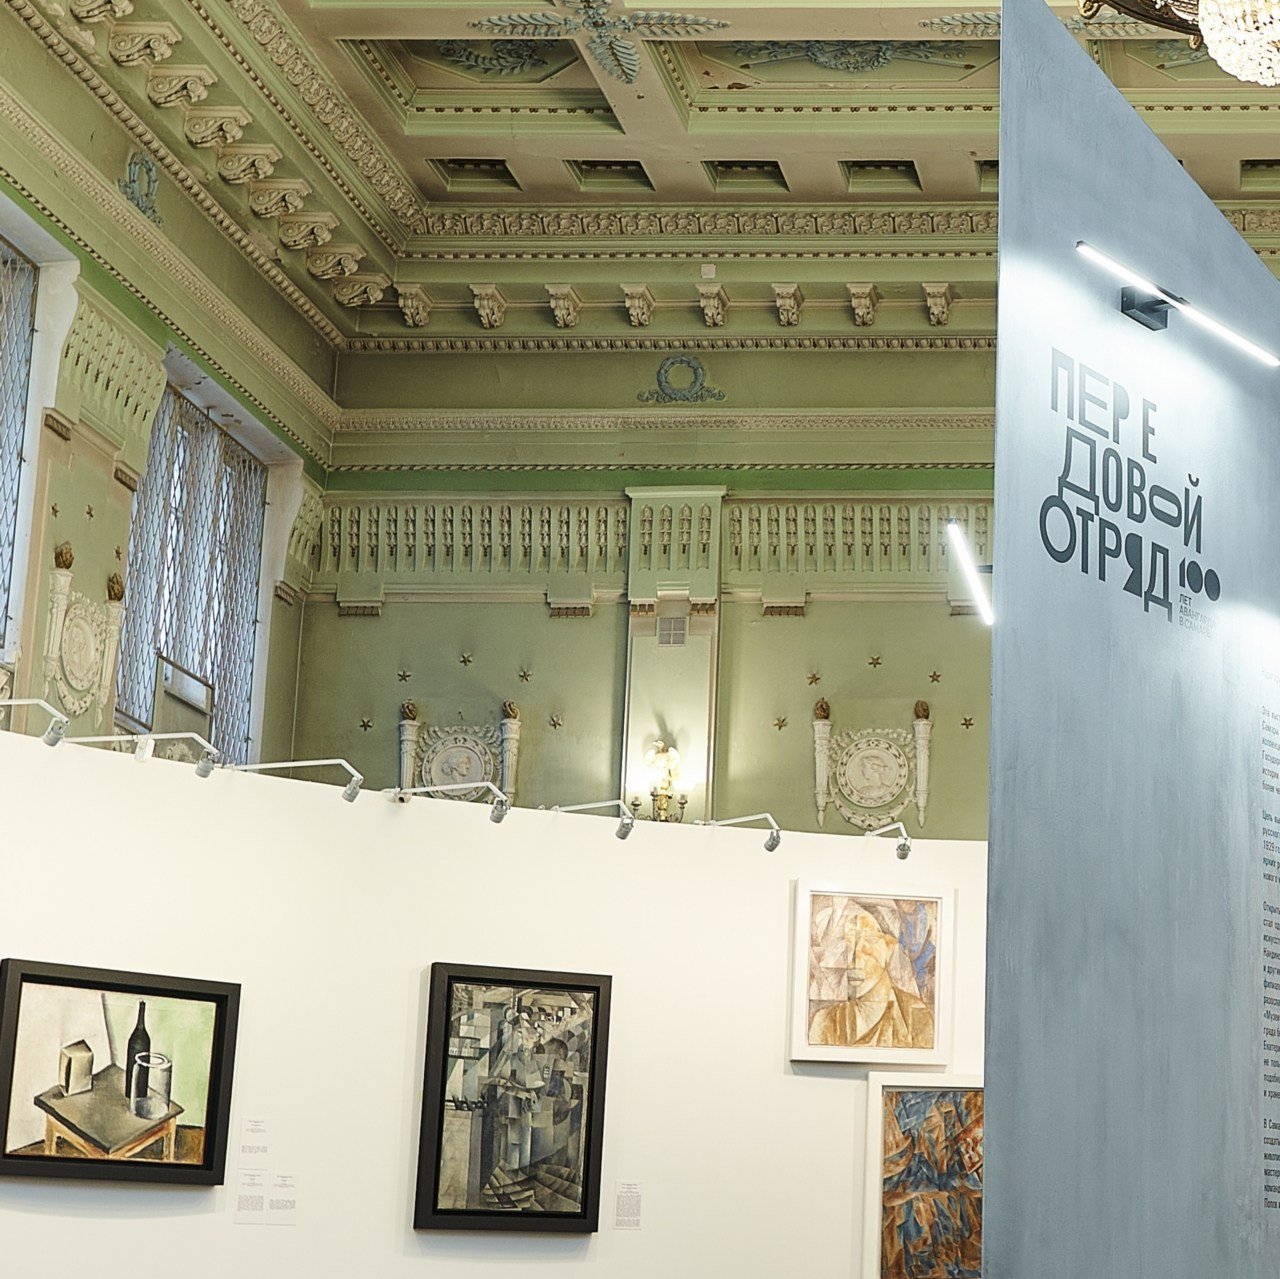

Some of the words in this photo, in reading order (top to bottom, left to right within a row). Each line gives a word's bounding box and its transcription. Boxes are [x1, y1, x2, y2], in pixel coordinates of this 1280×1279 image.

[1058, 425, 1202, 554] ДОВОЙ
[1039, 495, 1173, 623] ОТРЯД
[1179, 557, 1221, 602] 100
[1179, 593, 1192, 607] ЛЕТ
